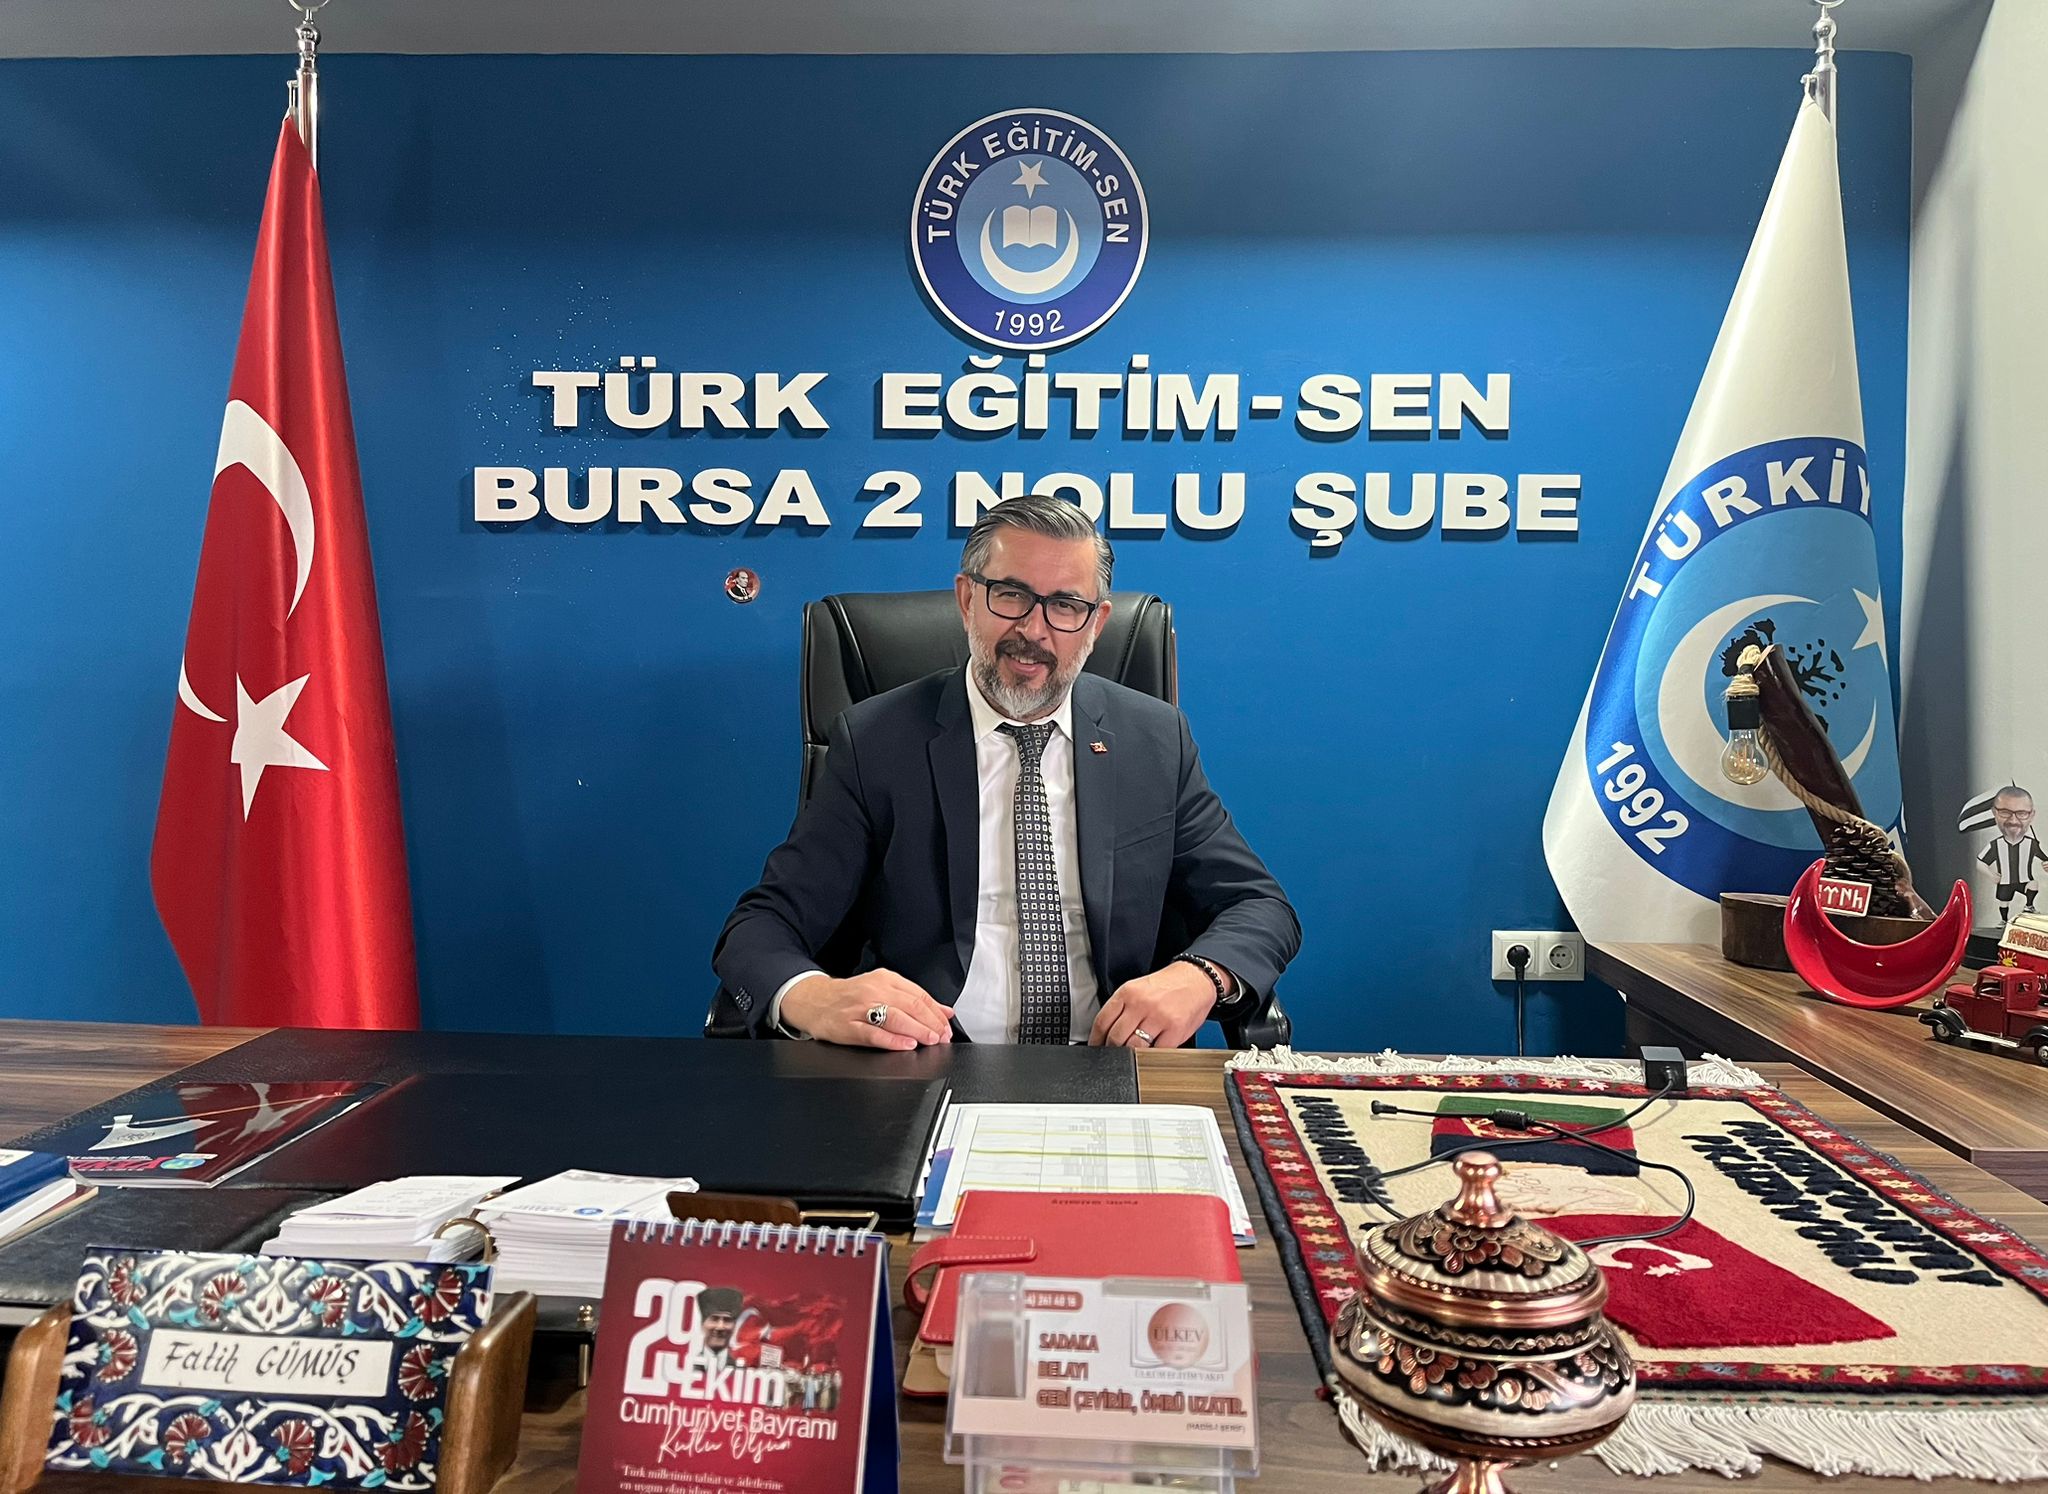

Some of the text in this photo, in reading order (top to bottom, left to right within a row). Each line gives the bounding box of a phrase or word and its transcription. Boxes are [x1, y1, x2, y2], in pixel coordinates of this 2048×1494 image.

[924, 120, 1130, 244] TÜRK EĞİTİM-SEN
[994, 309, 1065, 336] 1992
[532, 353, 1511, 432] TÜRK EĞİTİM-SEN
[474, 466, 1581, 547] BURSA 2 NOLU ŞUBE
[1595, 741, 1689, 855] 1992
[163, 1340, 359, 1384] Fatih GÜMÜŞ
[624, 1278, 708, 1396] 29
[1039, 1333, 1100, 1352] SADAKA
[680, 1355, 785, 1407] Ekim
[1036, 1387, 1072, 1409] GERİ
[1141, 1391, 1185, 1412] ÖMRÜ
[1188, 1395, 1248, 1417] UZATIR.
[620, 1396, 838, 1441] Cumhuriyet Bayramı
